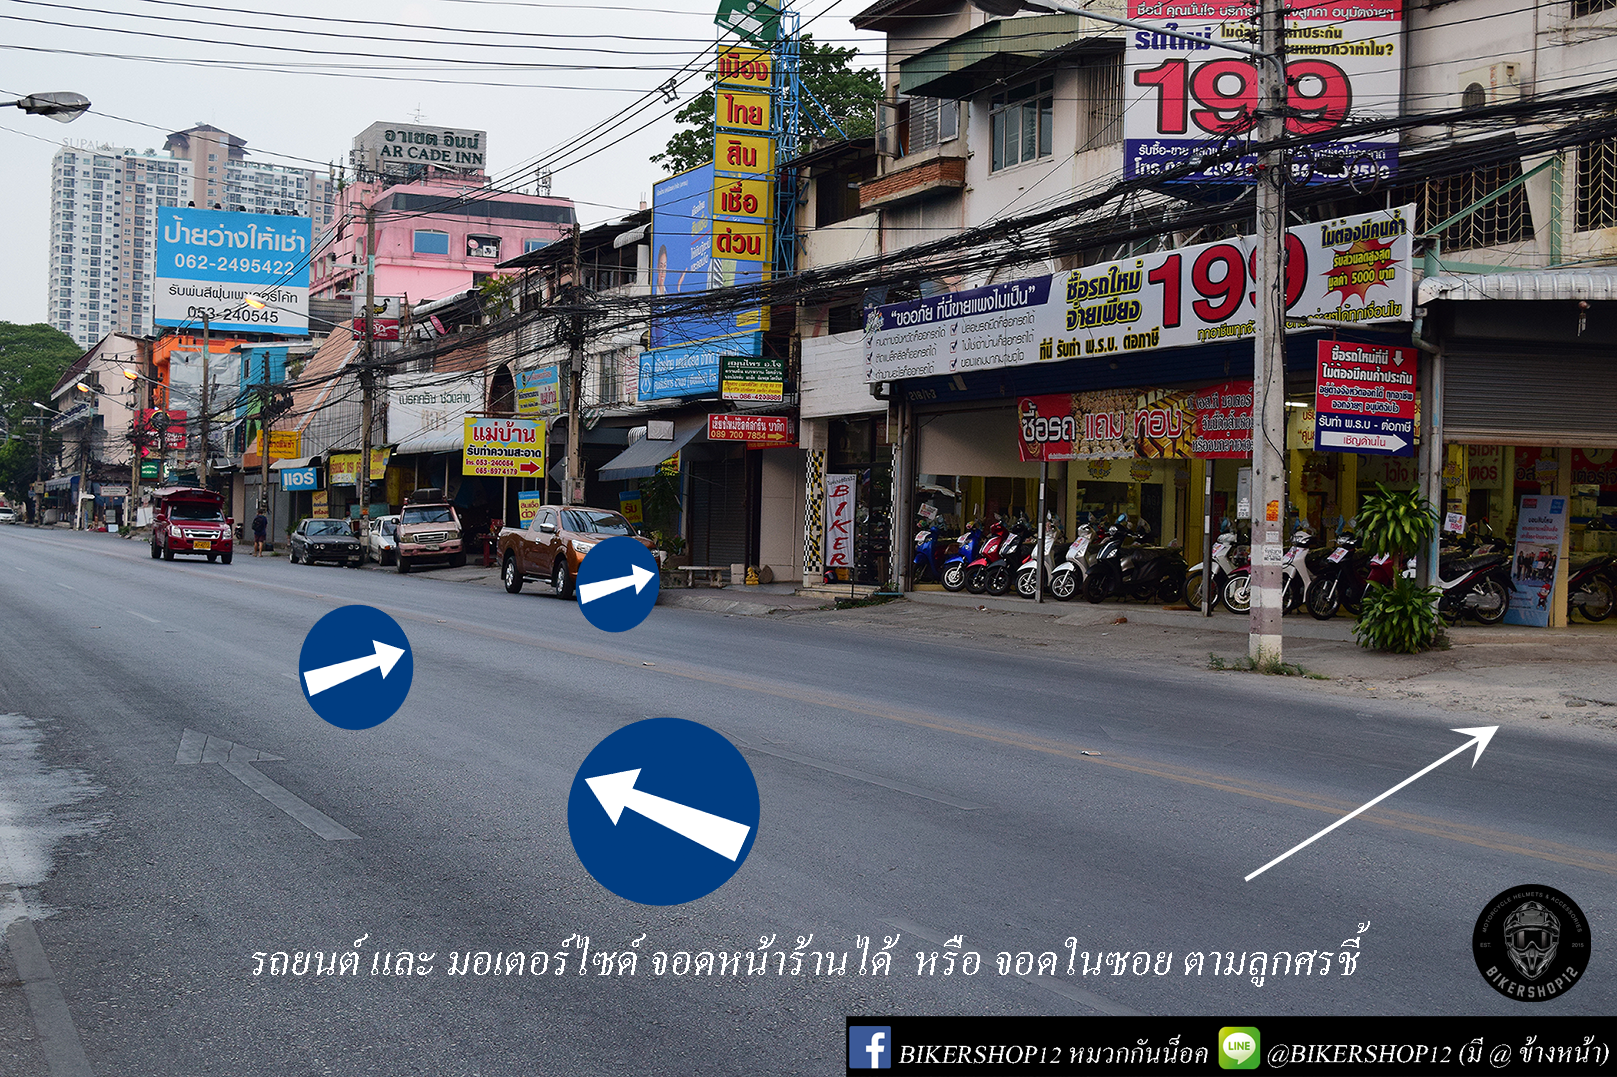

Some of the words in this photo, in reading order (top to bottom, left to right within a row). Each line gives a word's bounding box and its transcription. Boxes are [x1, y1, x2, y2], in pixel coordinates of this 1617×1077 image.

[719, 53, 769, 81] เมือง
[724, 94, 763, 125] ไทย
[1133, 58, 1353, 135] 199
[384, 130, 438, 146] อาเขต
[444, 131, 480, 150] อินน์
[407, 147, 451, 162] CADE
[455, 151, 483, 165] INN
[726, 140, 757, 167] สิน
[721, 181, 758, 213] เชื่อ
[164, 214, 306, 253] ป้ายว่างให้เช่า
[716, 227, 762, 256] ด่วน
[1321, 209, 1406, 248] ไม่ต้องมีคนค้ำ
[174, 253, 295, 276] 062-2495422
[1066, 259, 1144, 303] ซื้อรถใหม่
[1328, 271, 1348, 292] มูลค่า
[1351, 268, 1375, 285] 5000
[1378, 267, 1395, 281] บาท
[187, 305, 279, 323] 053-240545
[1066, 298, 1142, 331] จ่ายเพียง
[1039, 337, 1053, 360] ที่นี่
[1056, 337, 1081, 358] รับทำ
[1085, 336, 1118, 354] พ.ร.บ.
[1122, 326, 1160, 350] ต่อภาษี
[1331, 344, 1389, 365] ซื้อรถใหม่ที่นี่
[1322, 362, 1413, 385] ไม่ต้องมีคนค้ำประกัน
[473, 421, 536, 443] แม่บ้าน
[711, 430, 726, 438] 089
[729, 431, 744, 439] 700
[1021, 401, 1076, 444] ซื้อรถ
[1085, 411, 1124, 441] แถม
[1133, 408, 1183, 439] ทอง
[1318, 415, 1342, 428] รับทำ
[1345, 418, 1371, 429] พ.ร.บ
[1381, 419, 1411, 432] ต่อภาษี
[466, 444, 542, 458] รับทำความสะอาด
[1343, 435, 1386, 447] เชิญด้านใน
[284, 467, 315, 486] แอร์
[829, 484, 852, 566] BIKER
